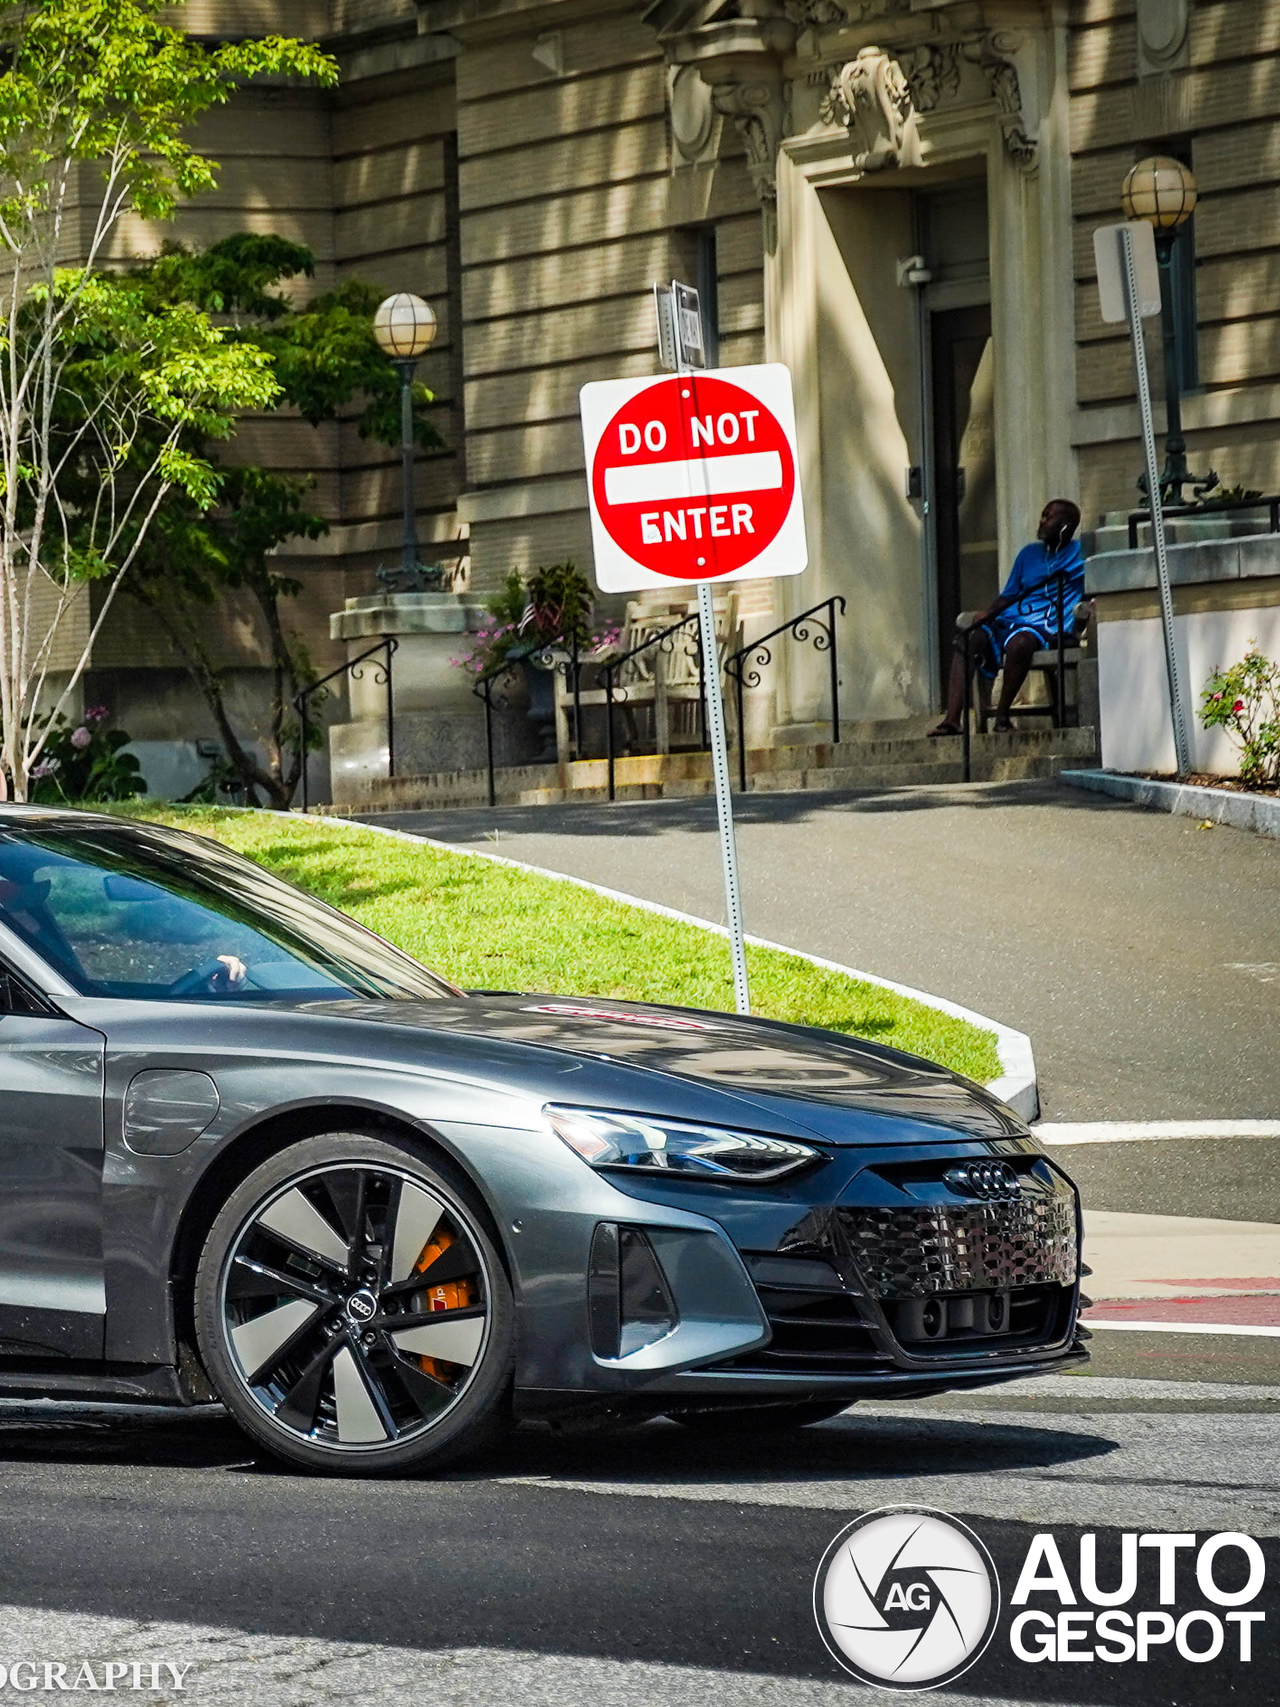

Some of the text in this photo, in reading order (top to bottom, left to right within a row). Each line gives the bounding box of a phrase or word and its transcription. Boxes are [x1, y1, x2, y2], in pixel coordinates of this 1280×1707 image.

[618, 410, 759, 455] DO NOT
[640, 503, 755, 545] ENTER
